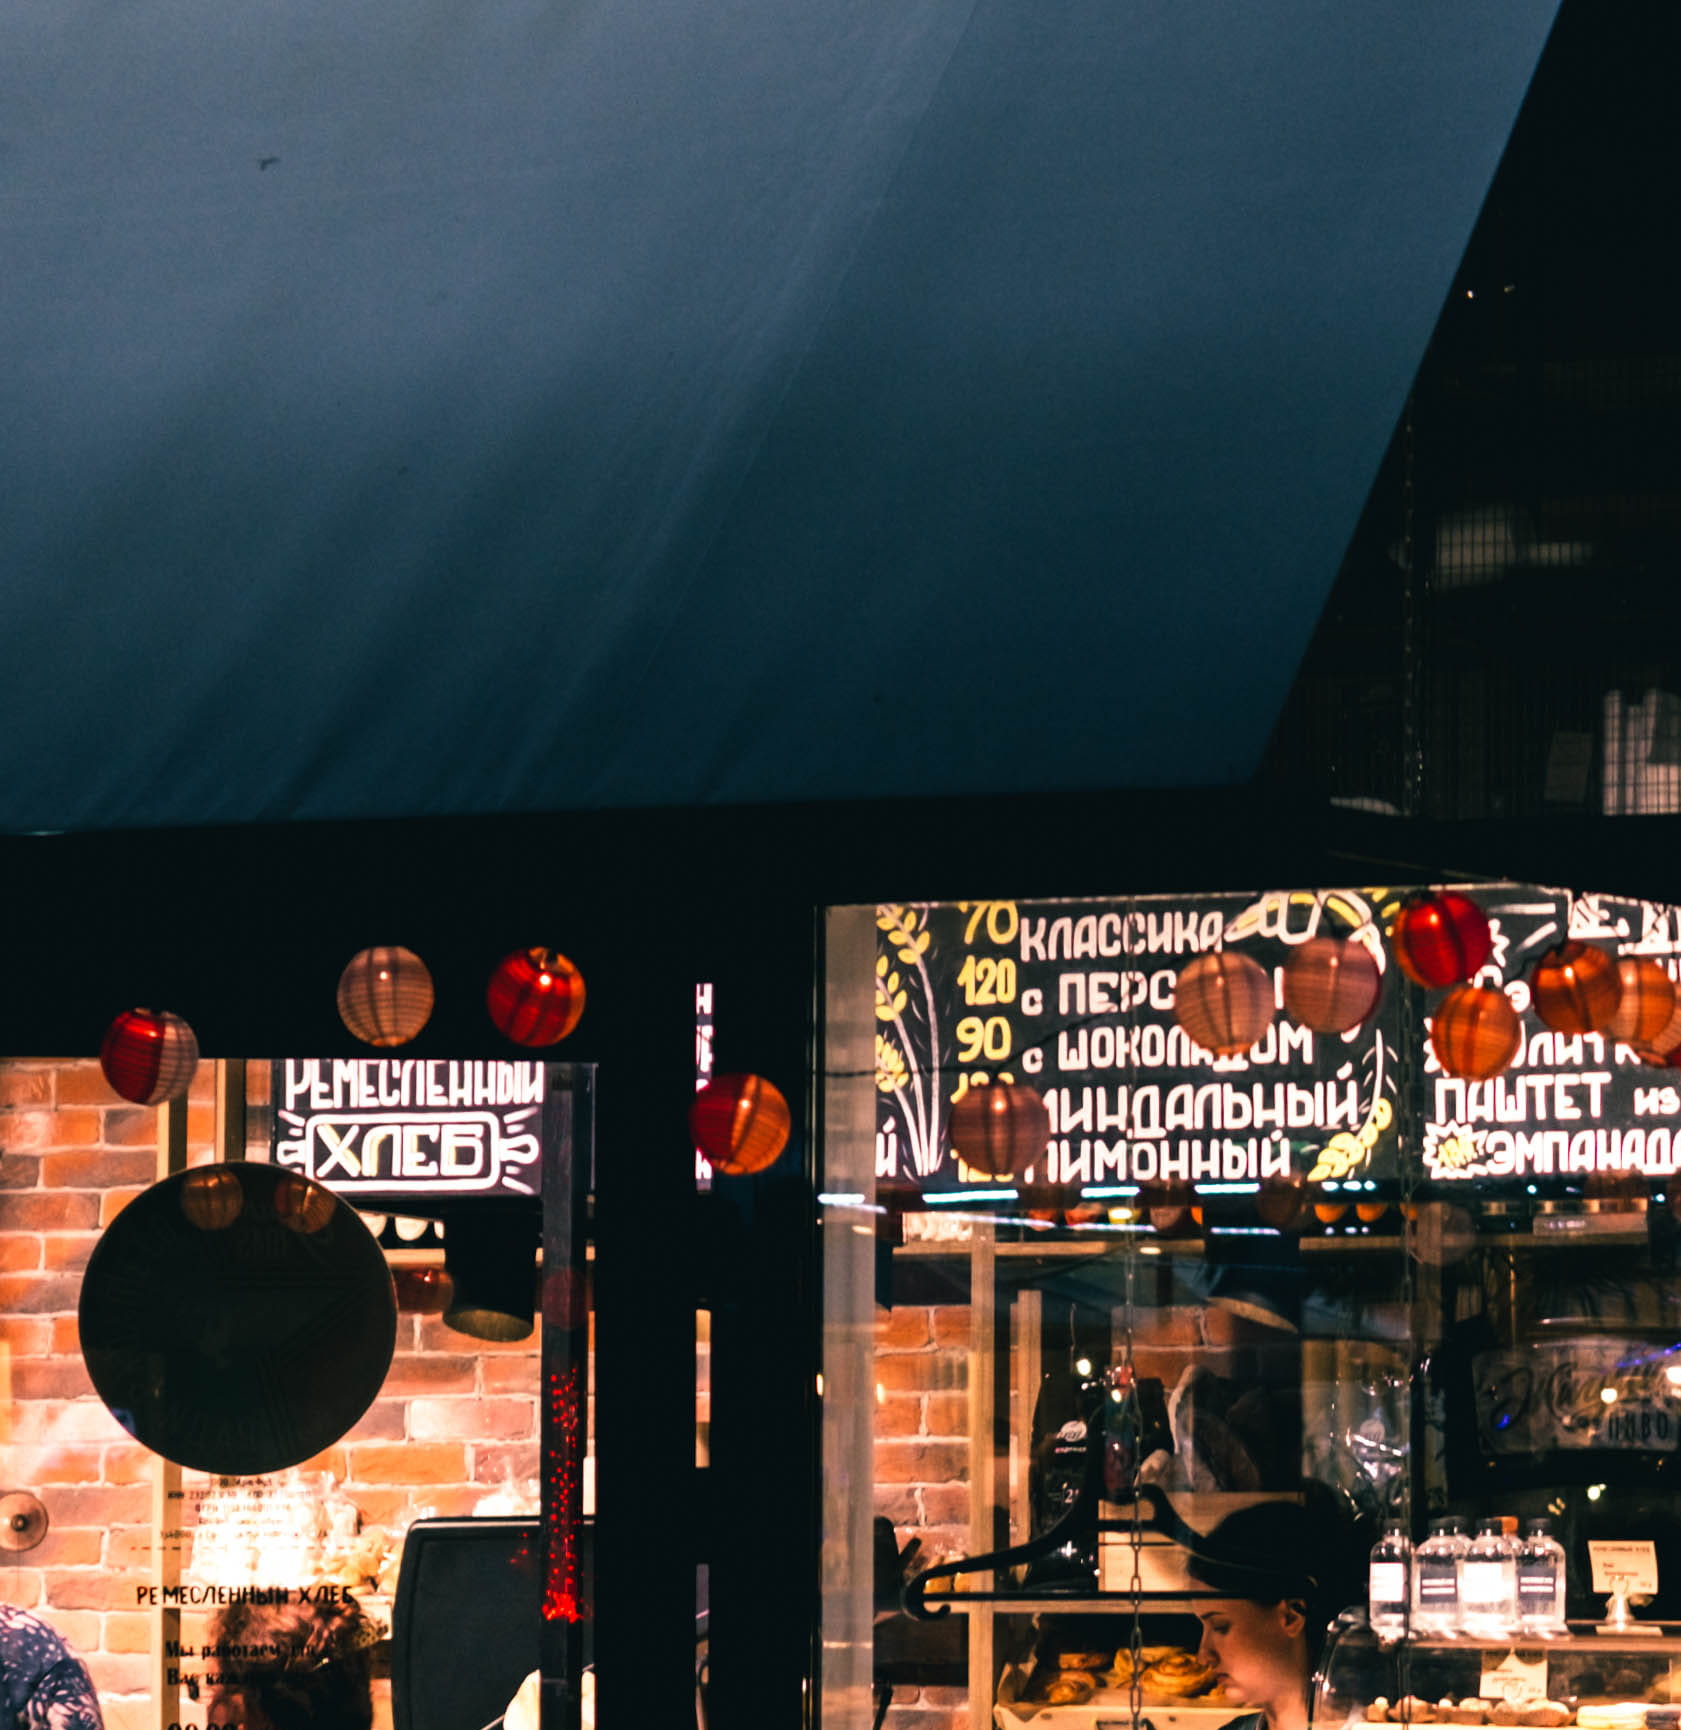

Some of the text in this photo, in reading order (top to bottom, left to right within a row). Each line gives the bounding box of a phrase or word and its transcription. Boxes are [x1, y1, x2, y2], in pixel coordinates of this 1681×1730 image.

[957, 900, 1223, 962] 70 КЛАССИКА
[956, 956, 1017, 1006] 120
[956, 1016, 1013, 1062] 90
[1434, 1071, 1613, 1125] ПАШТЕТ
[315, 1123, 485, 1178] ХЛЕБ
[297, 1585, 354, 1605] ХЛЕБ
